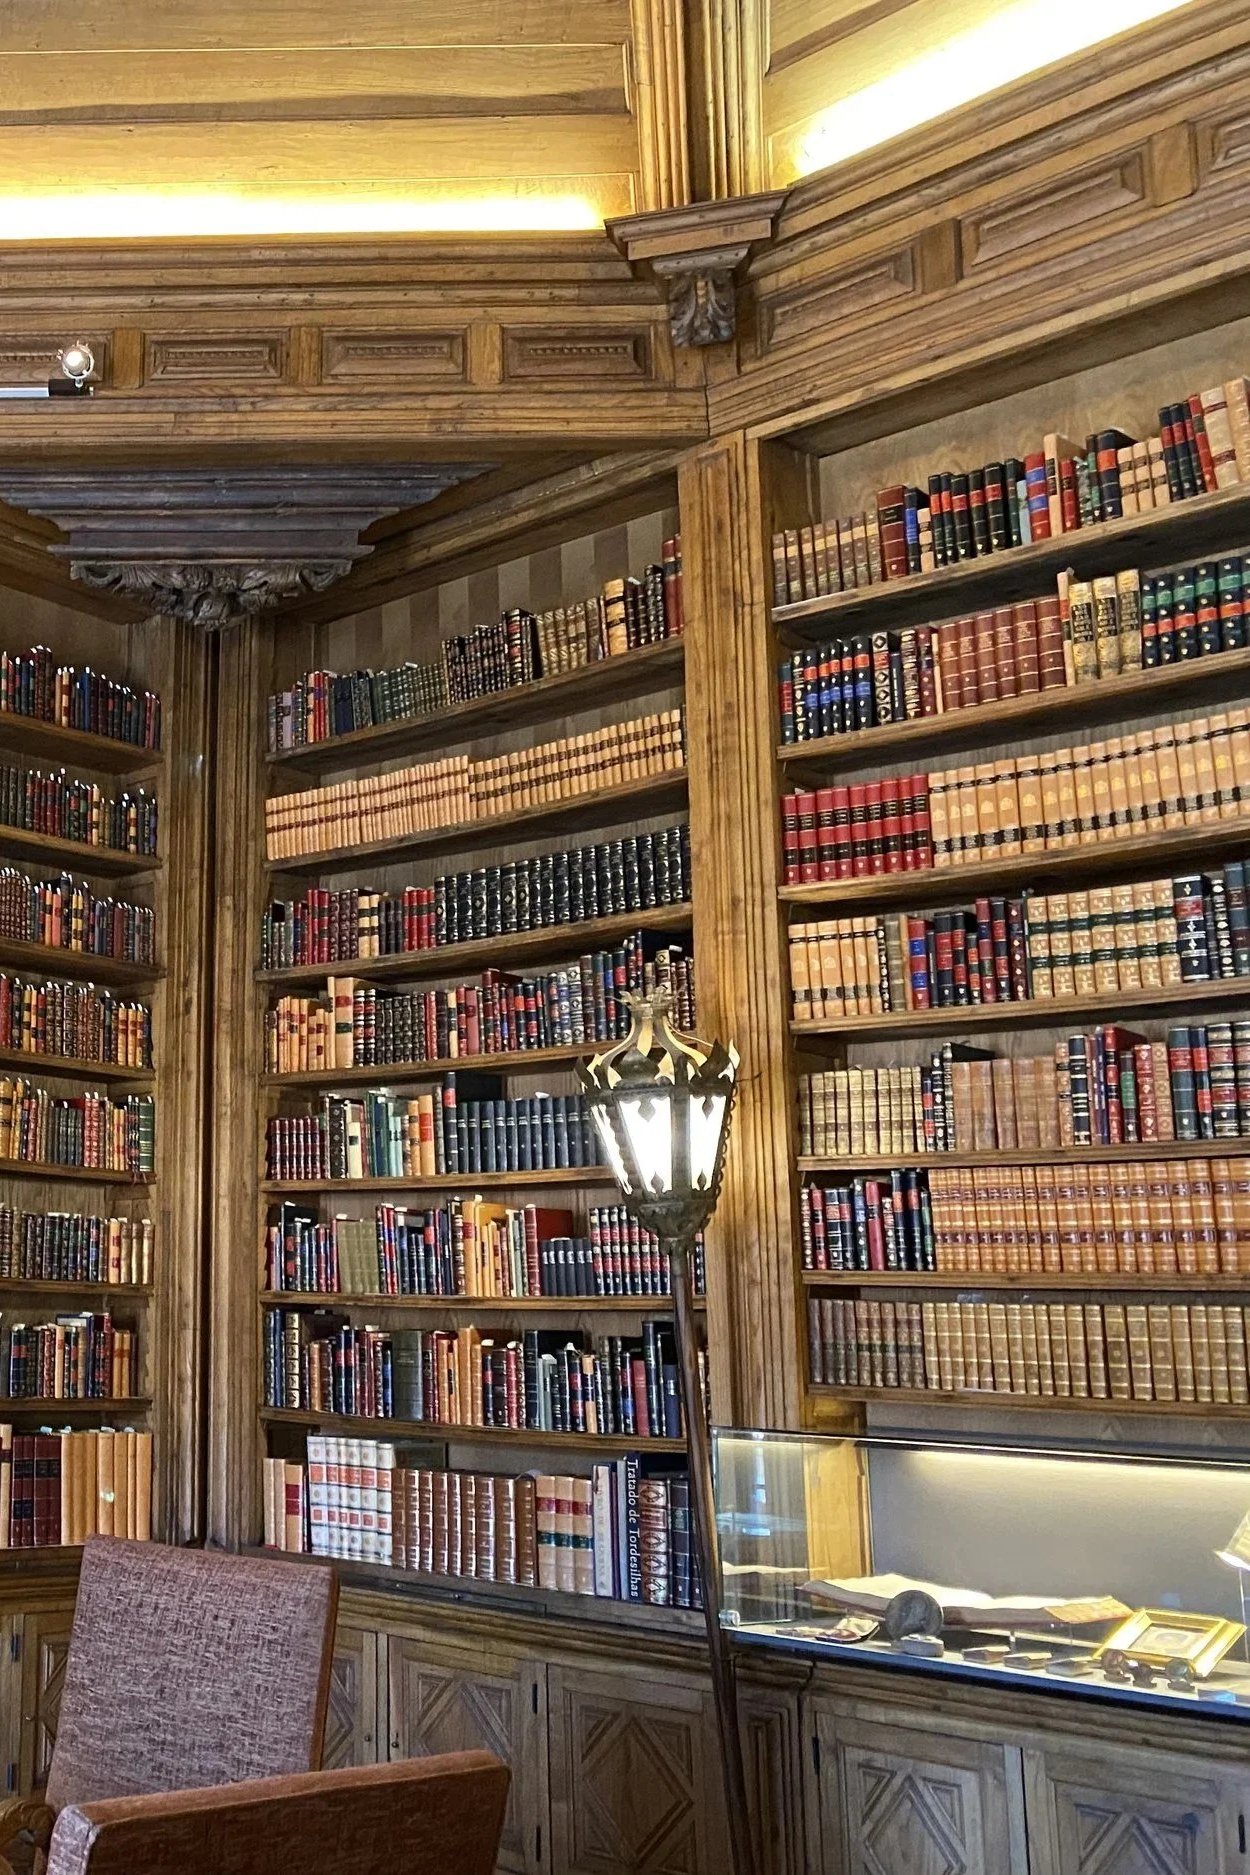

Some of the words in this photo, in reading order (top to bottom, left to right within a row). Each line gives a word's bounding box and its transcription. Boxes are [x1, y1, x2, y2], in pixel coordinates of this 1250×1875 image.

[627, 1459, 639, 1505] Tratado
[628, 1509, 640, 1524] de
[628, 1528, 642, 1597] Tordesilhas
